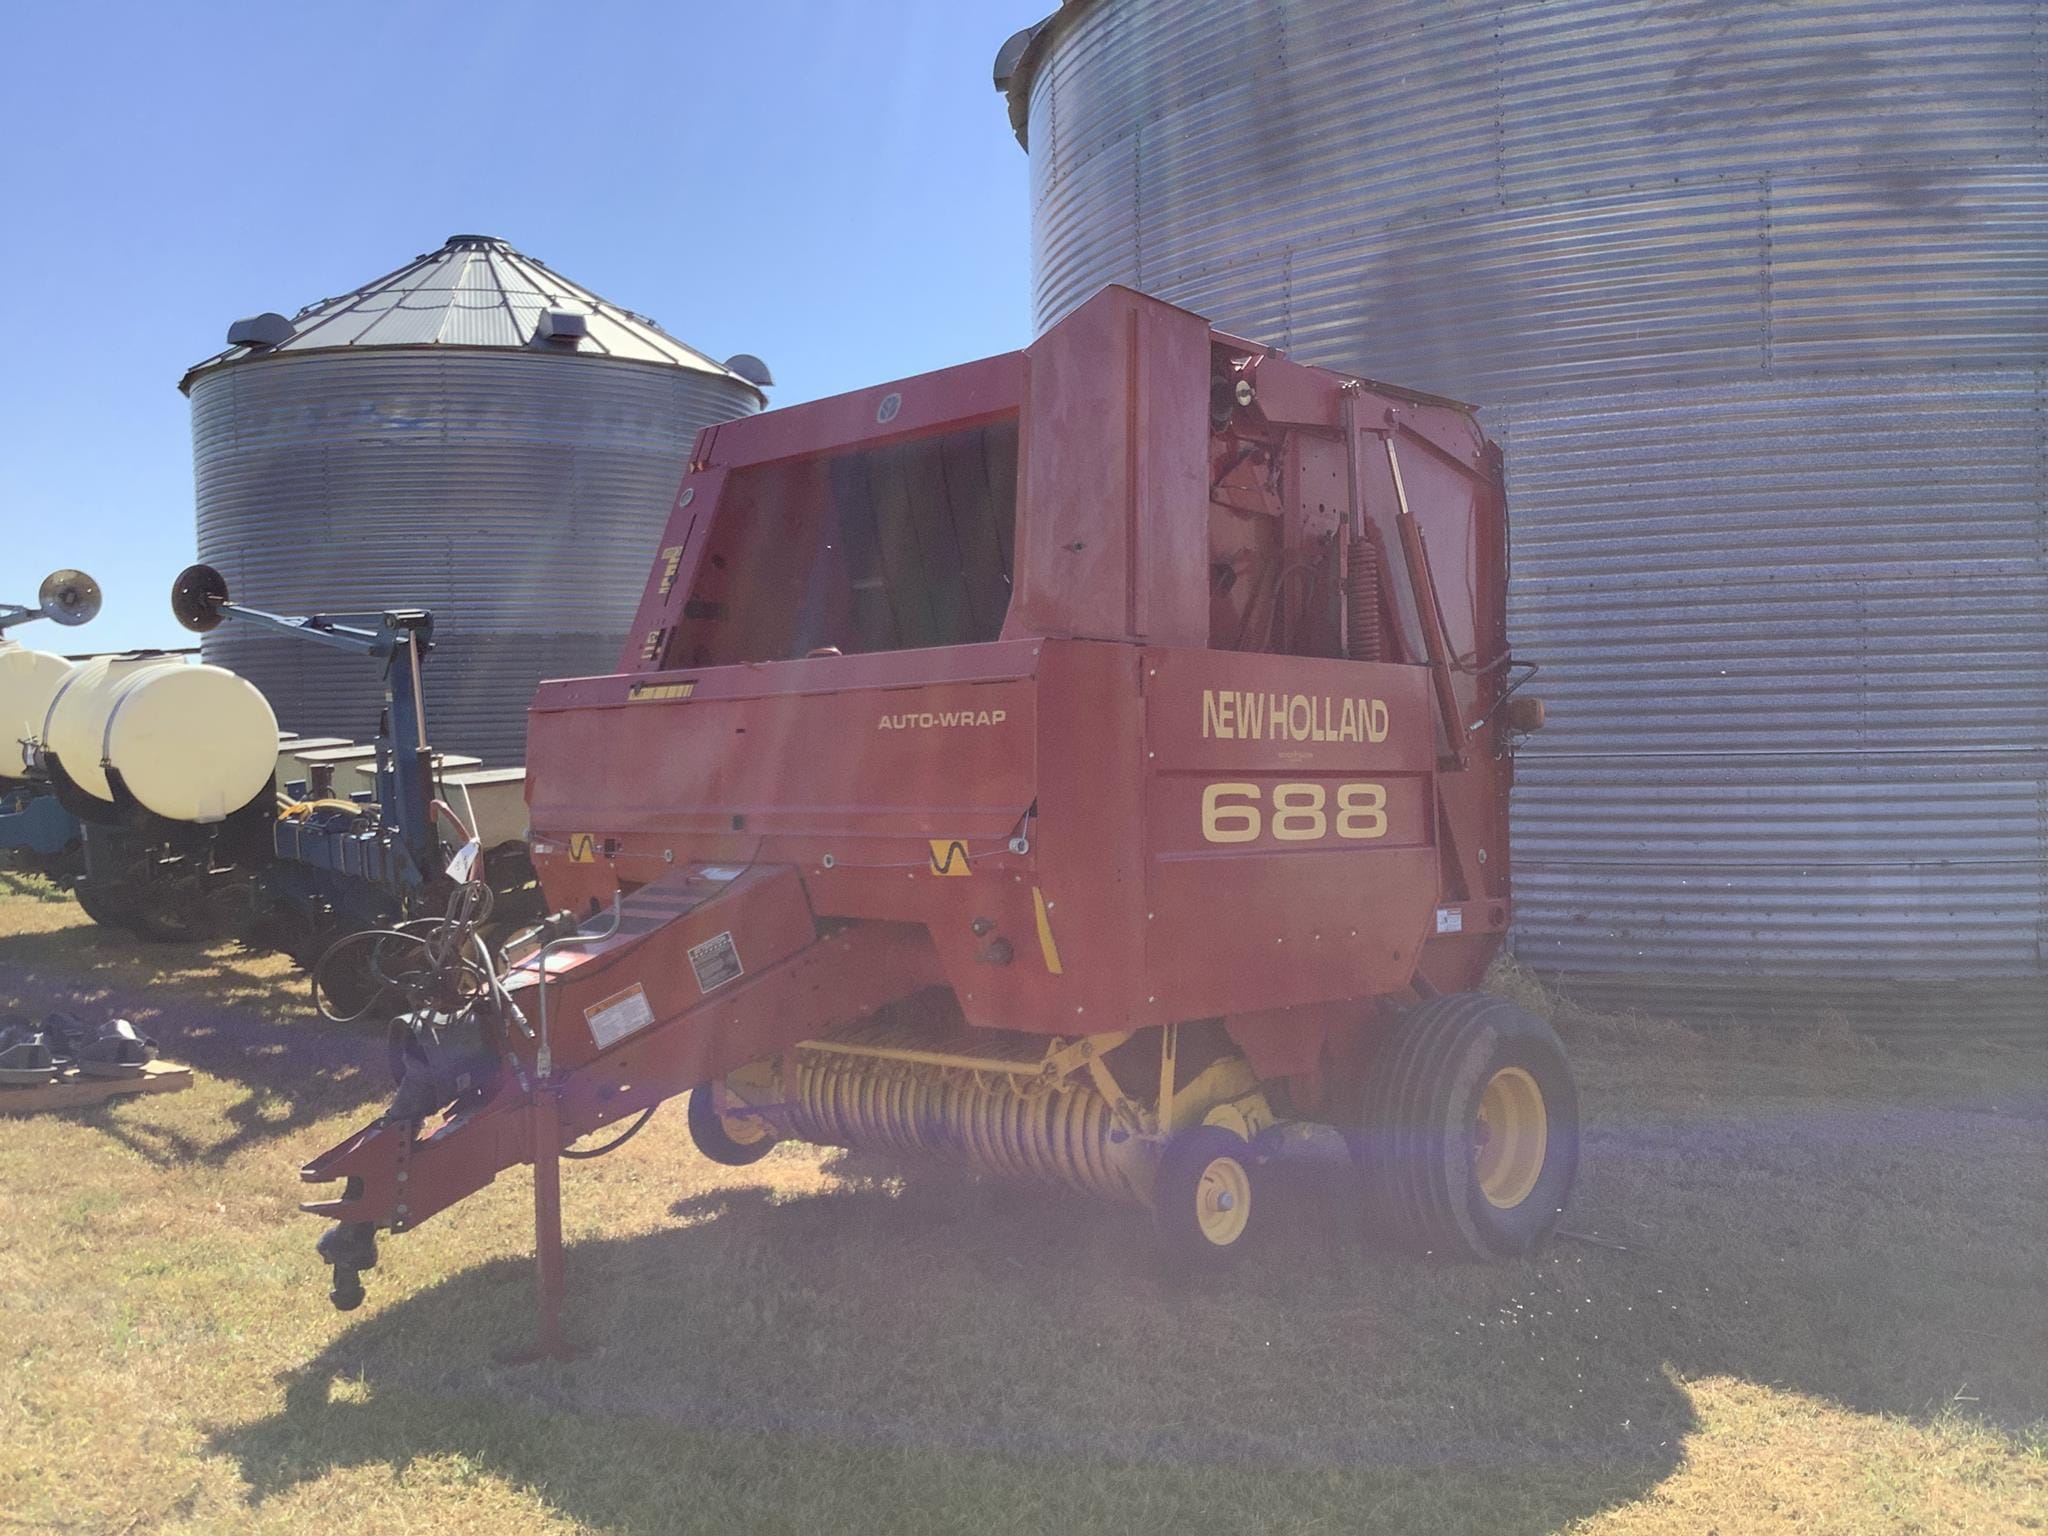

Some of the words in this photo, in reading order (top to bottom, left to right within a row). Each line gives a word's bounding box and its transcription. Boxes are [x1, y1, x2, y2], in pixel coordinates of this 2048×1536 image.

[878, 710, 1006, 730] AUTO-WRAP
[1203, 690, 1265, 739] NEW
[1270, 694, 1389, 743] HOLLAND
[1202, 783, 1388, 842] 688
